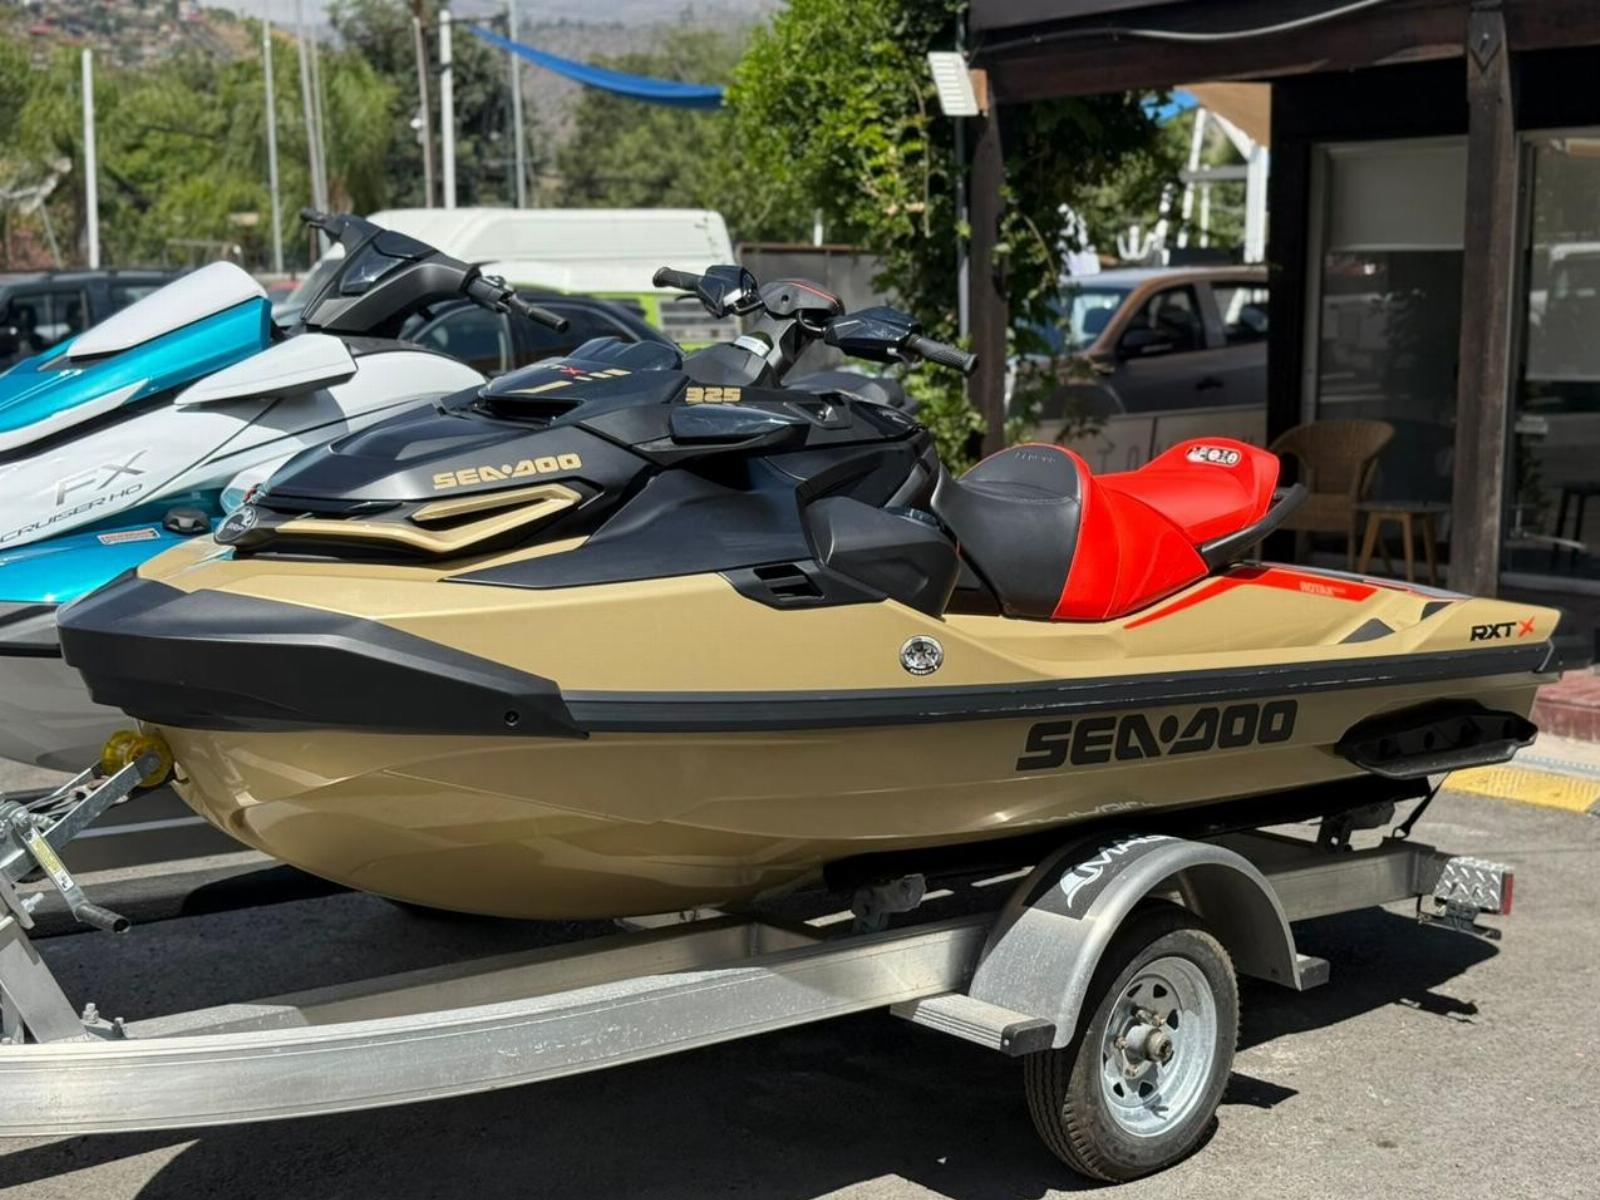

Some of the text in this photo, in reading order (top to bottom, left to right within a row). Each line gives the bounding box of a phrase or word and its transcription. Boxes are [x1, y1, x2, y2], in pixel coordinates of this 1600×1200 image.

[56, 449, 148, 506] FX
[1470, 614, 1537, 641] RXT X
